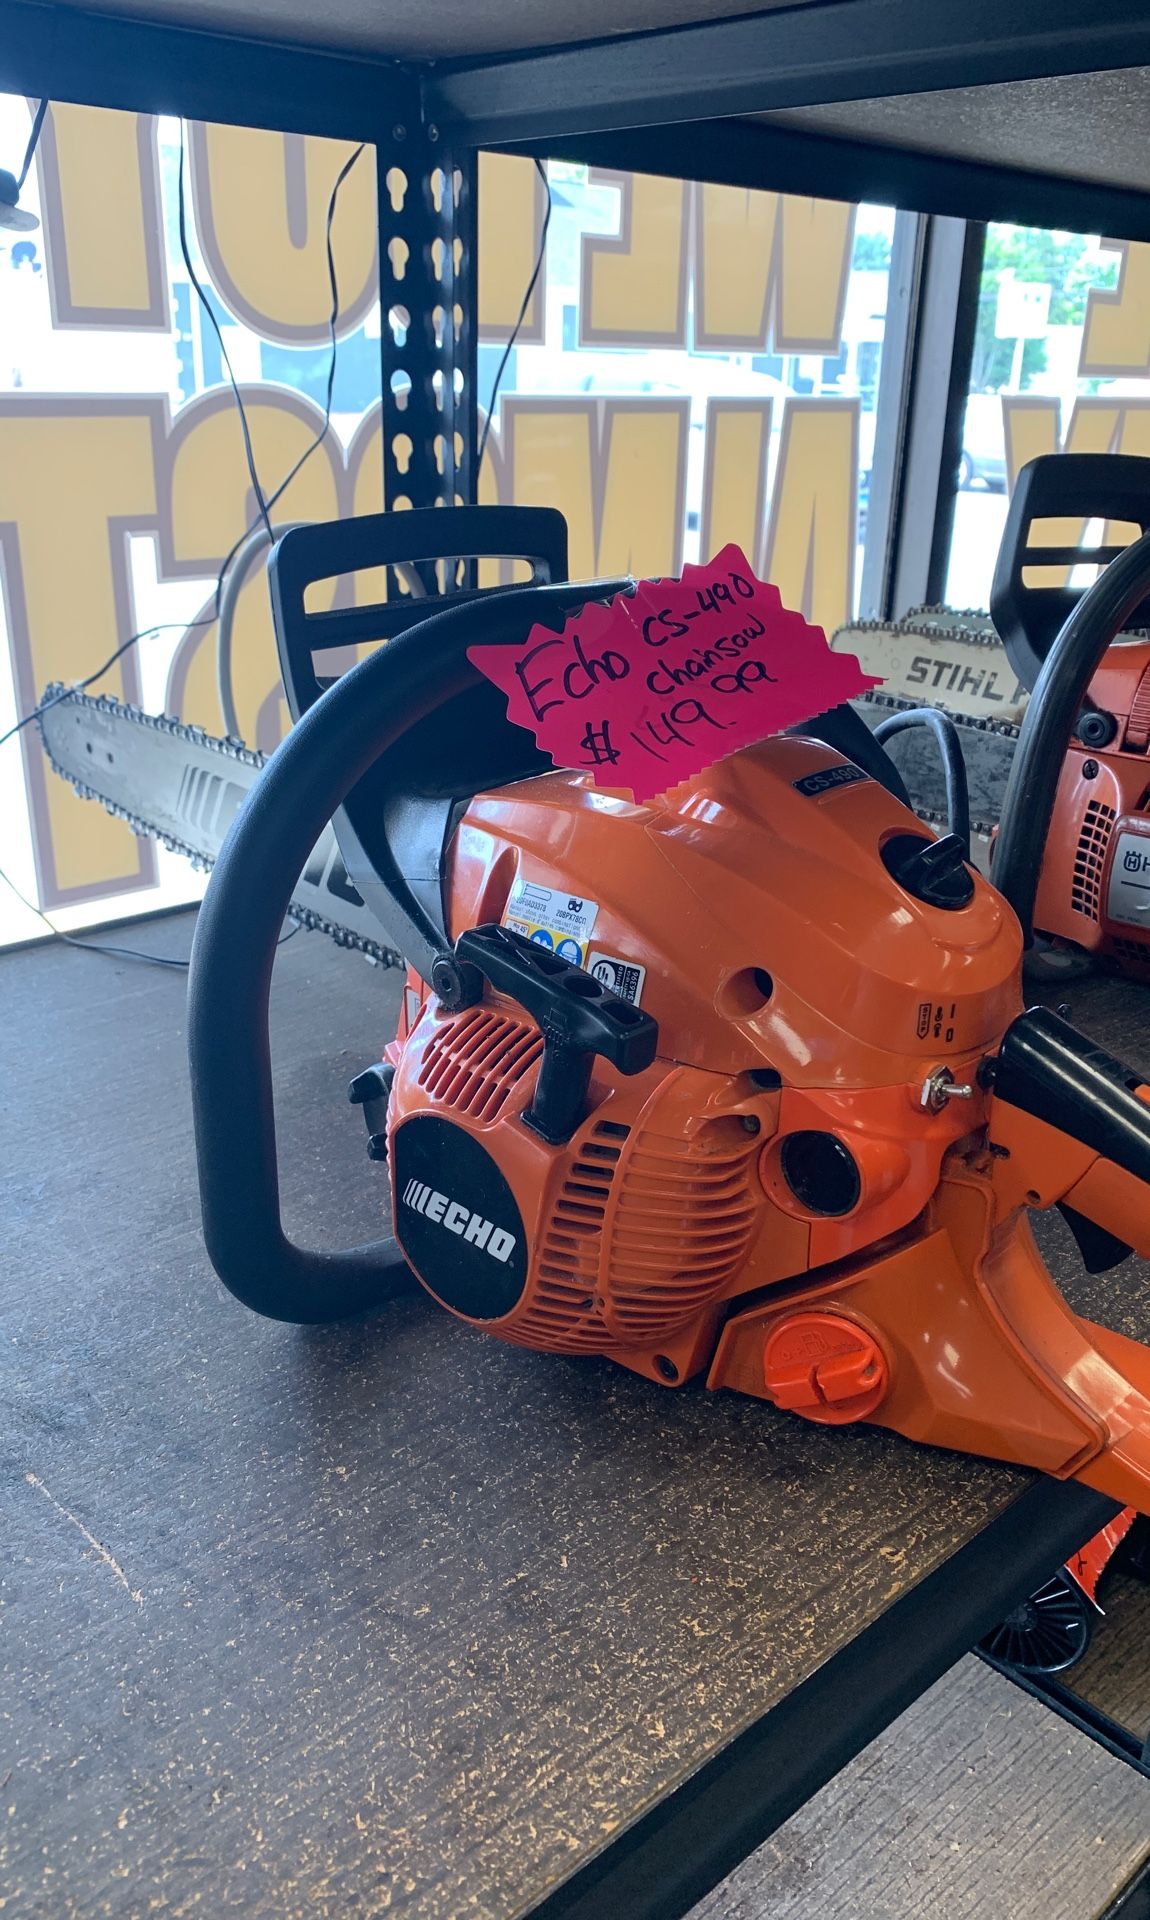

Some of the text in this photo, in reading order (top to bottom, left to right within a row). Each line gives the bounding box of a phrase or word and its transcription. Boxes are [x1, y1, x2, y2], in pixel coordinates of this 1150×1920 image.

[515, 572, 755, 722] Echo CS-490
[906, 655, 1004, 701] STIHL
[804, 768, 860, 792] CS-490
[627, 971, 639, 1000] SA6396
[424, 1190, 517, 1263] ECHO
